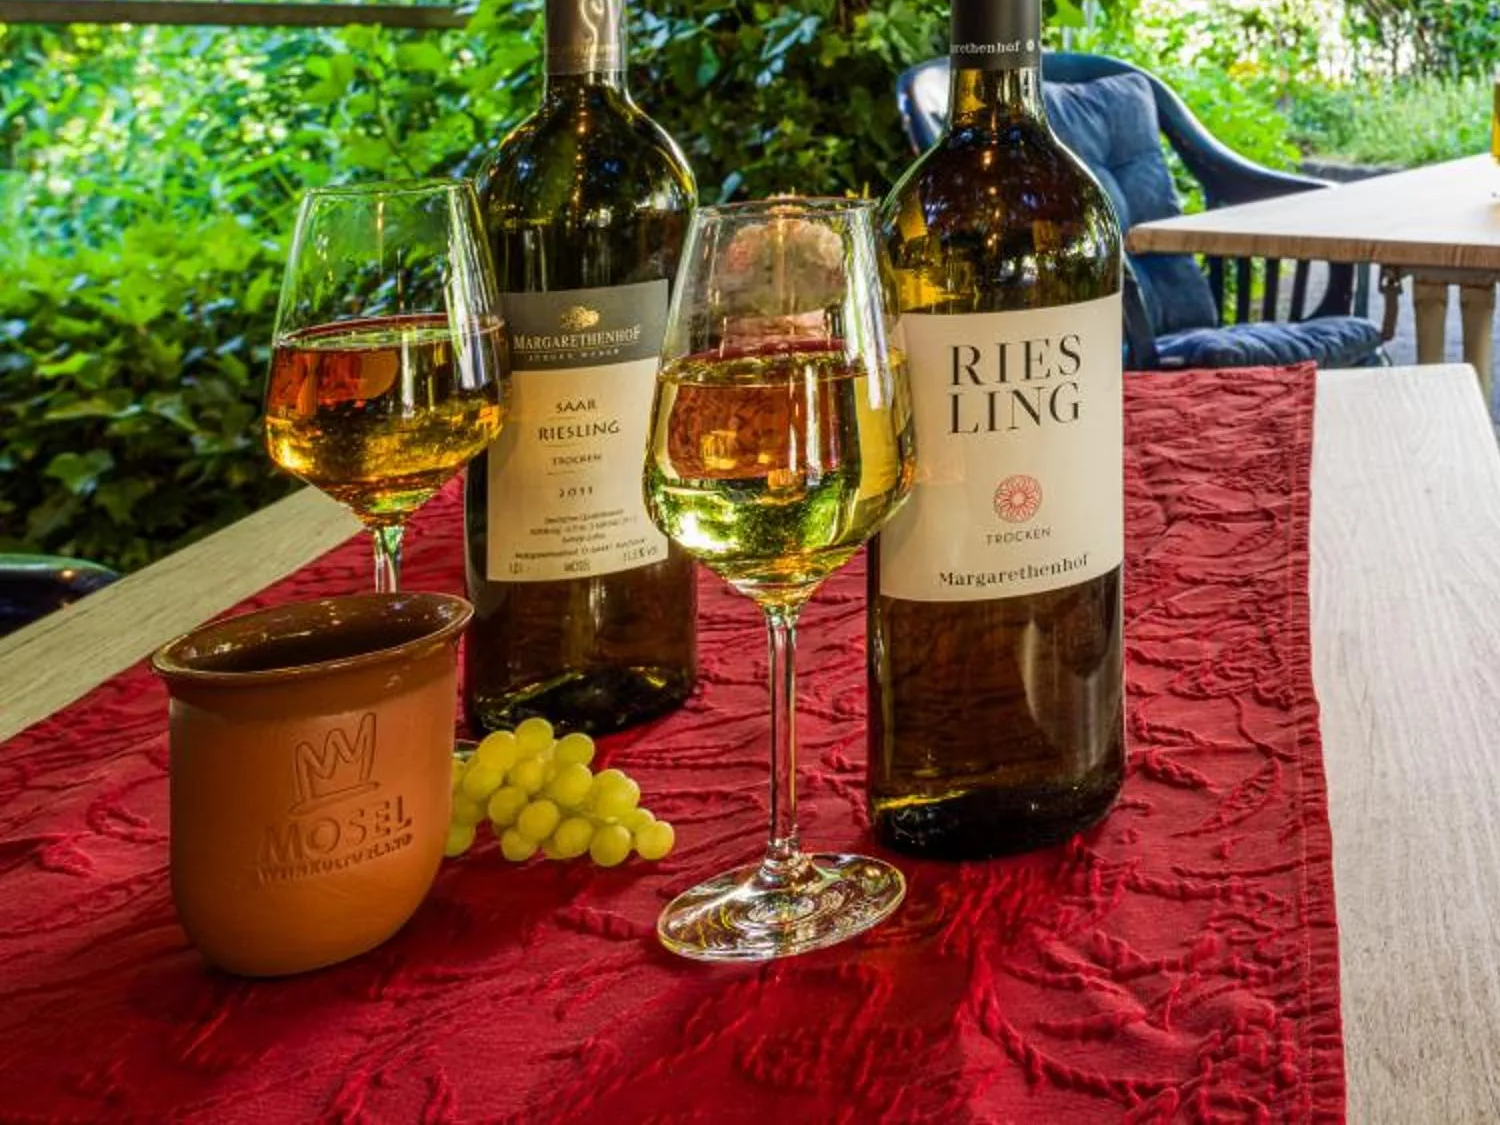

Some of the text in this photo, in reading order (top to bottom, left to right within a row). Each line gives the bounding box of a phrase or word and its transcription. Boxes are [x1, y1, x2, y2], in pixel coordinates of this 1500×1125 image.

[513, 324, 641, 351] MARGARETHENHOF
[948, 334, 1082, 386] RIES
[555, 398, 597, 414] SAAR
[948, 382, 1083, 435] LING
[538, 419, 621, 442] RIESLING
[986, 527, 1051, 547] TROCKEN
[939, 553, 1091, 588] Margarethenhof
[257, 793, 414, 863] MOSEL
